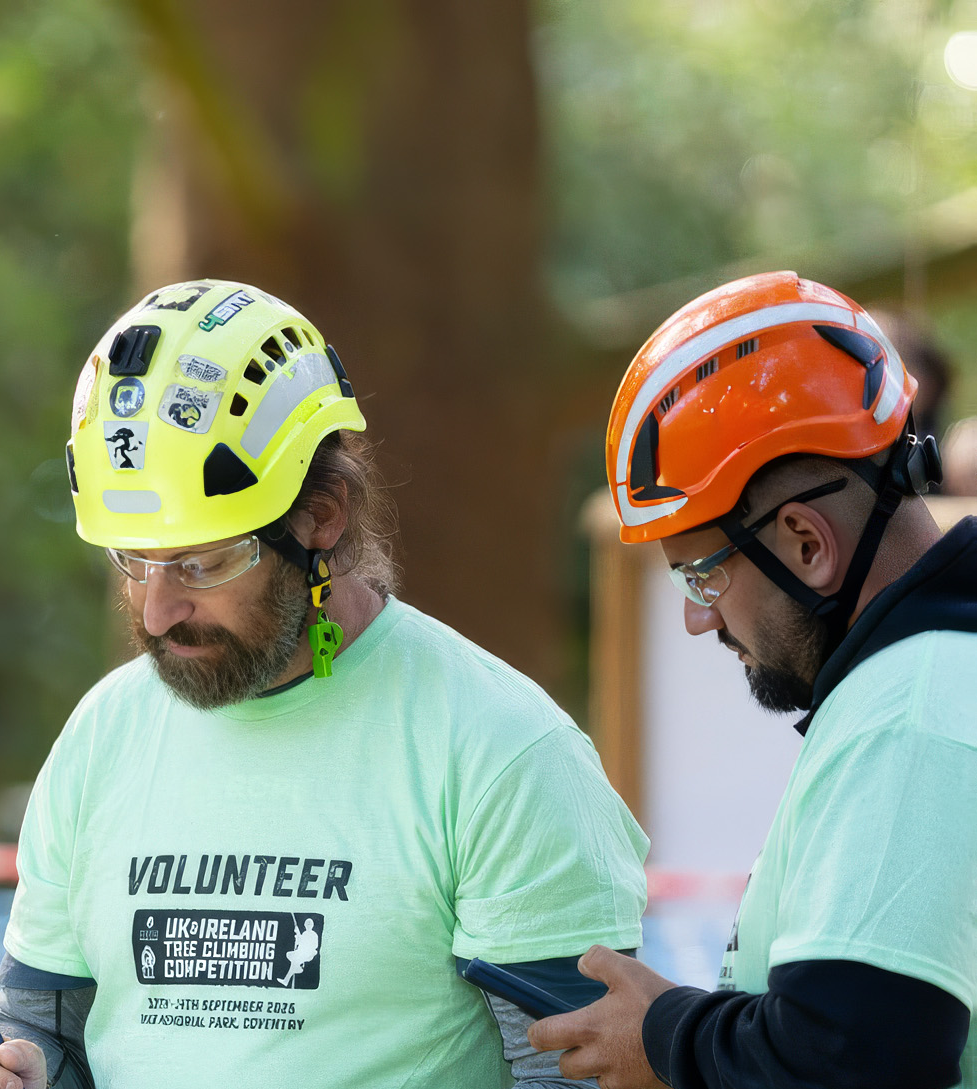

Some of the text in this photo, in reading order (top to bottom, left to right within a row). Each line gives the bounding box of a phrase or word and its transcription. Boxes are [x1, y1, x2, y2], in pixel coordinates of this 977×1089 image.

[128, 855, 353, 901] VOLUNTEER
[163, 941, 276, 960] TREE CLIMBING
[164, 959, 274, 980] COMPETITION
